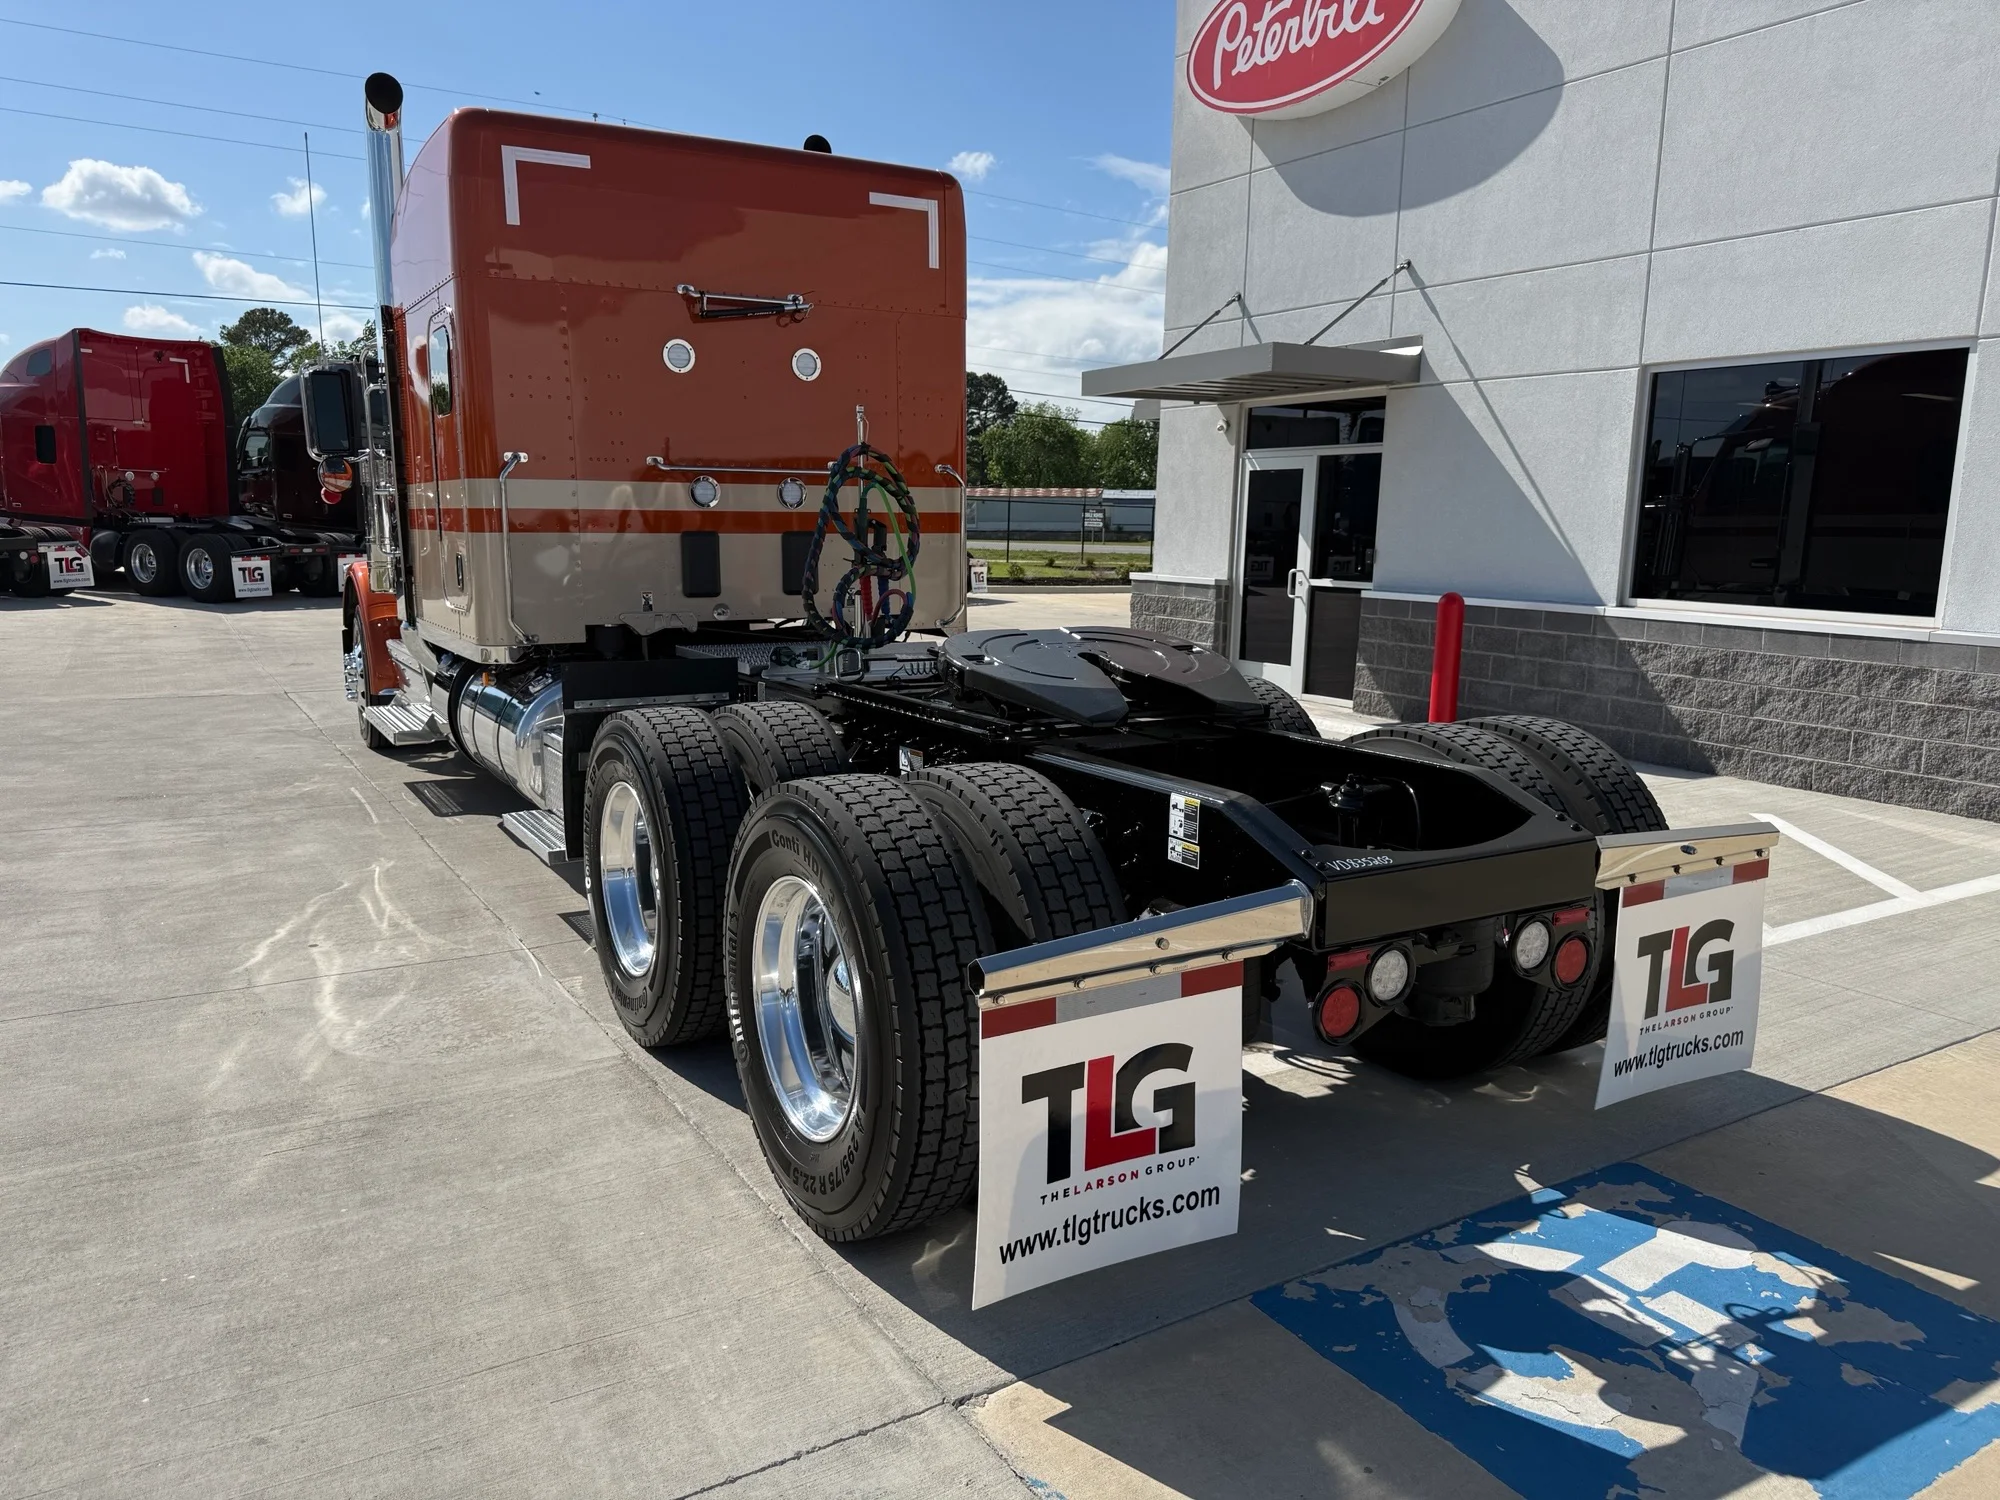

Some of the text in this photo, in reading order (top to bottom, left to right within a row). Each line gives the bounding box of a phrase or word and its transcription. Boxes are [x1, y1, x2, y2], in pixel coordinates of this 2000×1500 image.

[54, 557, 85, 573] TLG
[238, 567, 264, 583] TLG
[771, 829, 800, 856] Conti
[1637, 919, 1735, 1021] TLG
[1699, 1007, 1732, 1020] GROUP
[1613, 1029, 1744, 1078] www.tlgtrucks.com
[1021, 1042, 1196, 1186] TLG
[792, 1131, 859, 1196] 295/75 R 22.5
[1145, 1156, 1197, 1176] GROUP
[999, 1185, 1221, 1265] www.tlgtrucks.com
